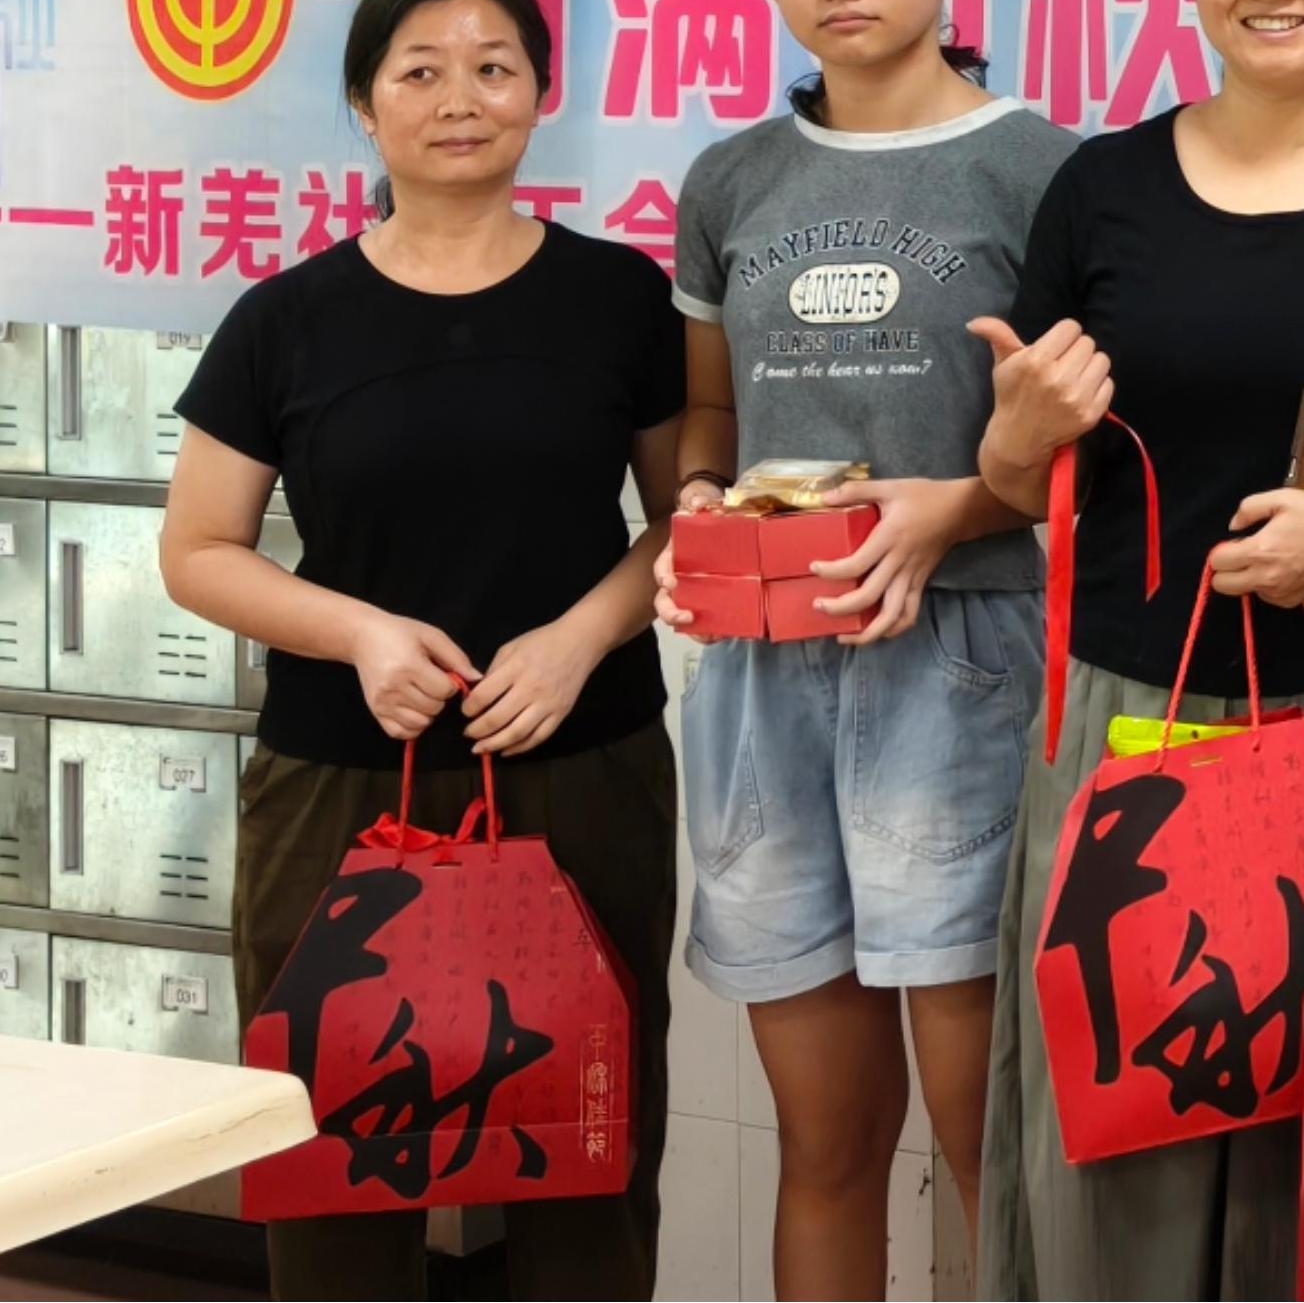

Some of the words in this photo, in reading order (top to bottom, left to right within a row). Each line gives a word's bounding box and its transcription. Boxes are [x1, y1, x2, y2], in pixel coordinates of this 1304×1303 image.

[739, 217, 890, 290] MAYFIELD
[892, 224, 969, 286] HIGH
[766, 331, 828, 354] CLASS
[832, 331, 854, 353] OF
[173, 769, 195, 784] 027
